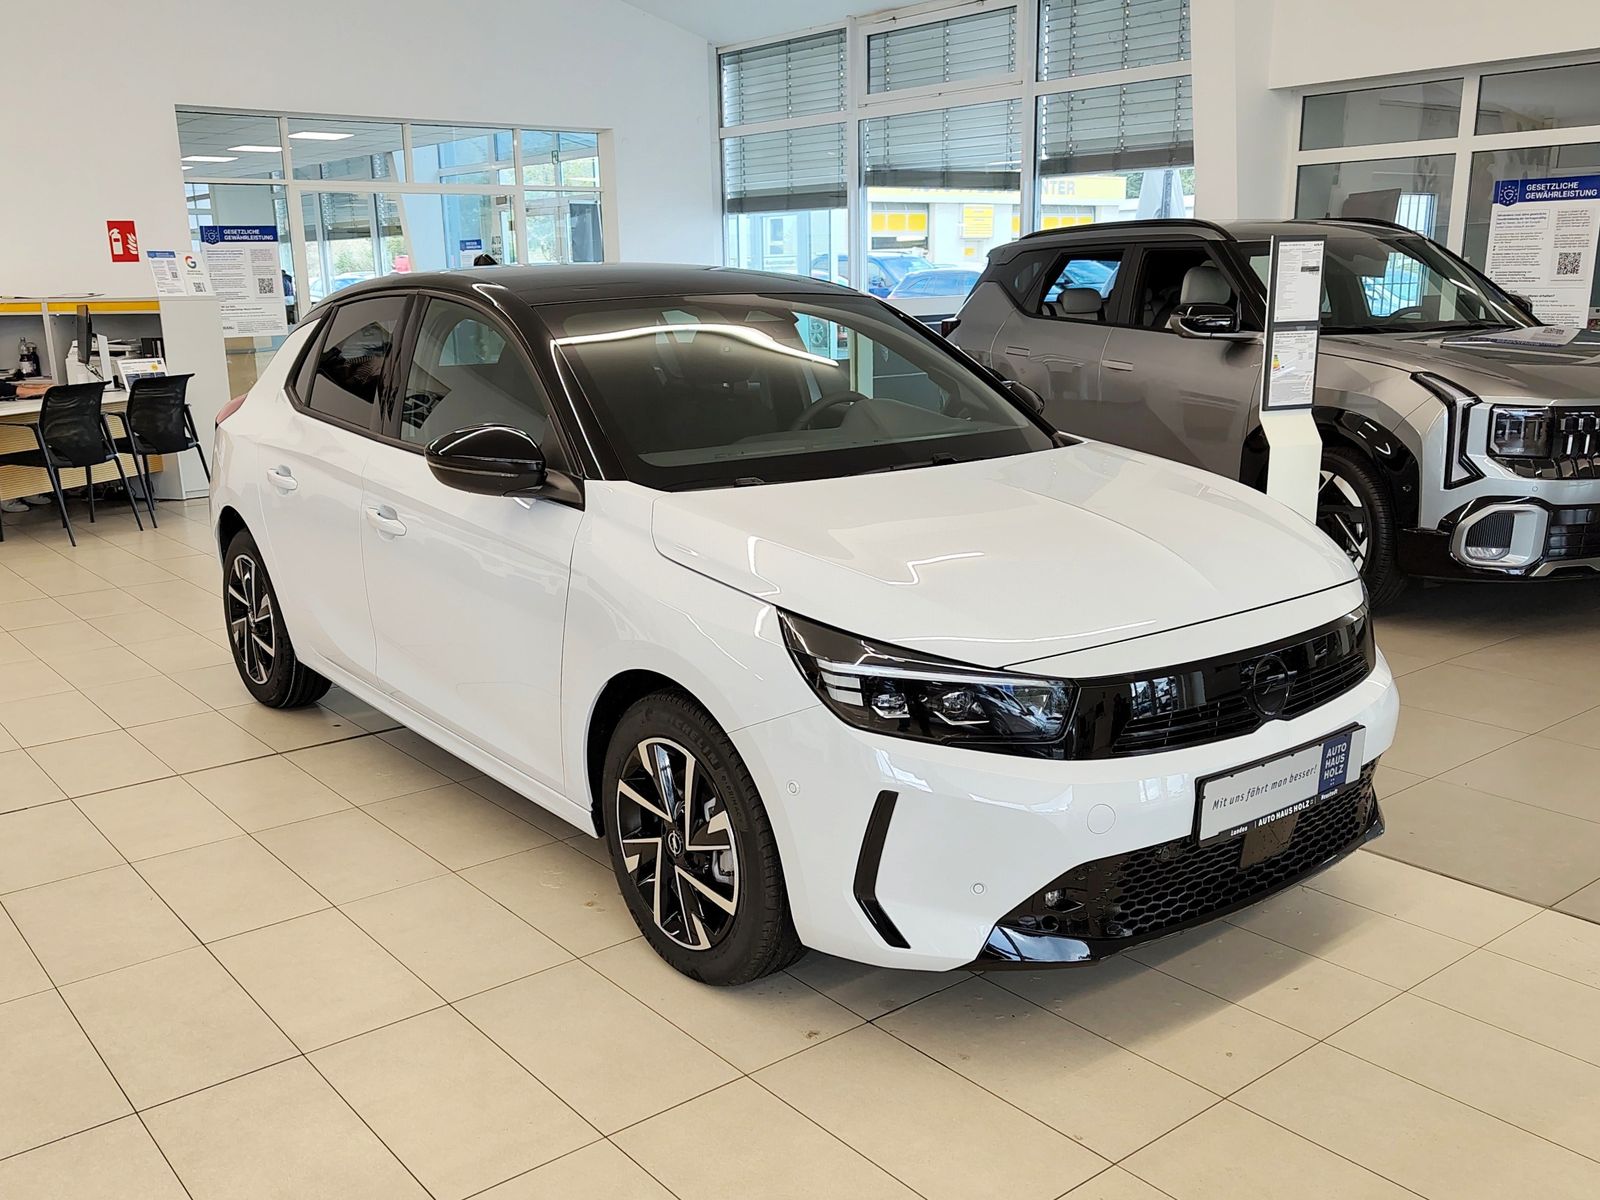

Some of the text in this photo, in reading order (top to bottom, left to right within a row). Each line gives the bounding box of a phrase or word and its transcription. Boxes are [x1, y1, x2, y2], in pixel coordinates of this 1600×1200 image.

[1043, 180, 1076, 196] NTER
[1525, 188, 1598, 200] GEWÄHRLEISTUNG
[1526, 181, 1579, 192] GESETZLICHE
[1326, 742, 1347, 759] AUTO
[1325, 753, 1346, 769] HAUS
[1323, 764, 1344, 780] HOLZ
[1212, 764, 1318, 811] Mit uns fährt man besser!
[1258, 800, 1310, 827] AUTO HAUS HOLZ
